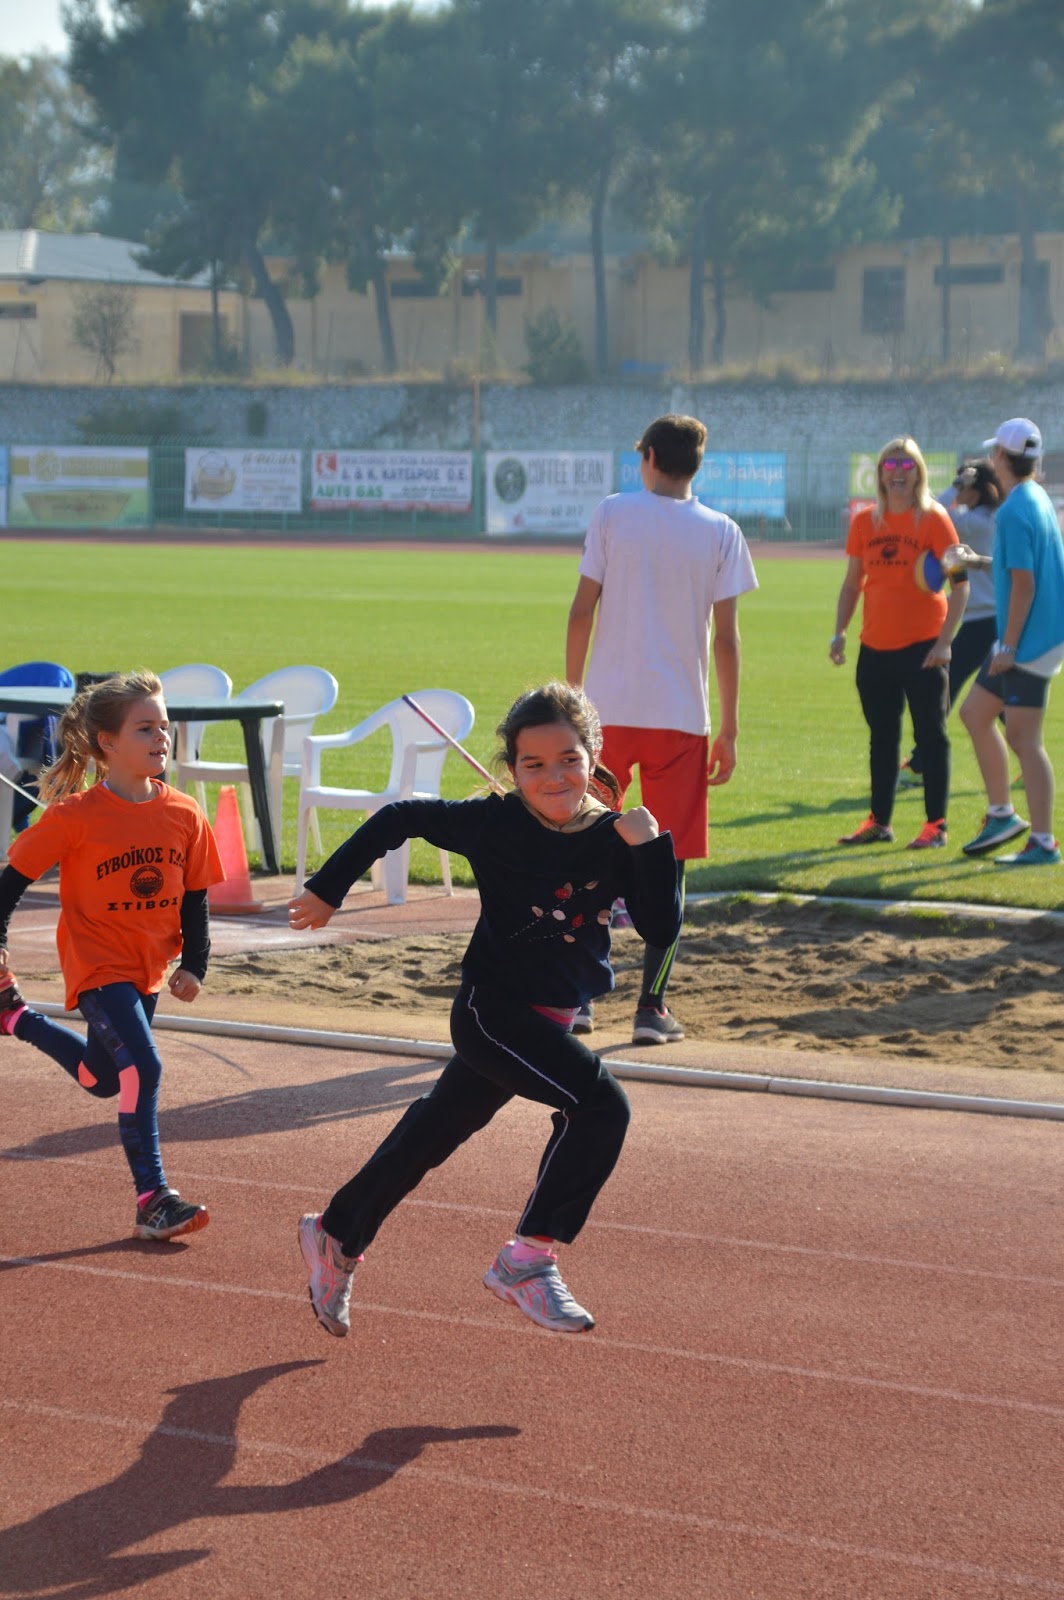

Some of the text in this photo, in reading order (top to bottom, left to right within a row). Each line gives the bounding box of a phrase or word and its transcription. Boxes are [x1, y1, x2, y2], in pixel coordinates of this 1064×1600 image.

[574, 458, 605, 485] BEAN
[316, 484, 351, 498] AUTO
[355, 484, 384, 498] GAS
[96, 845, 164, 881] ΕΥΒΟΪΚΟΣ
[107, 896, 179, 911] ΣΤΙΒΟΣ
